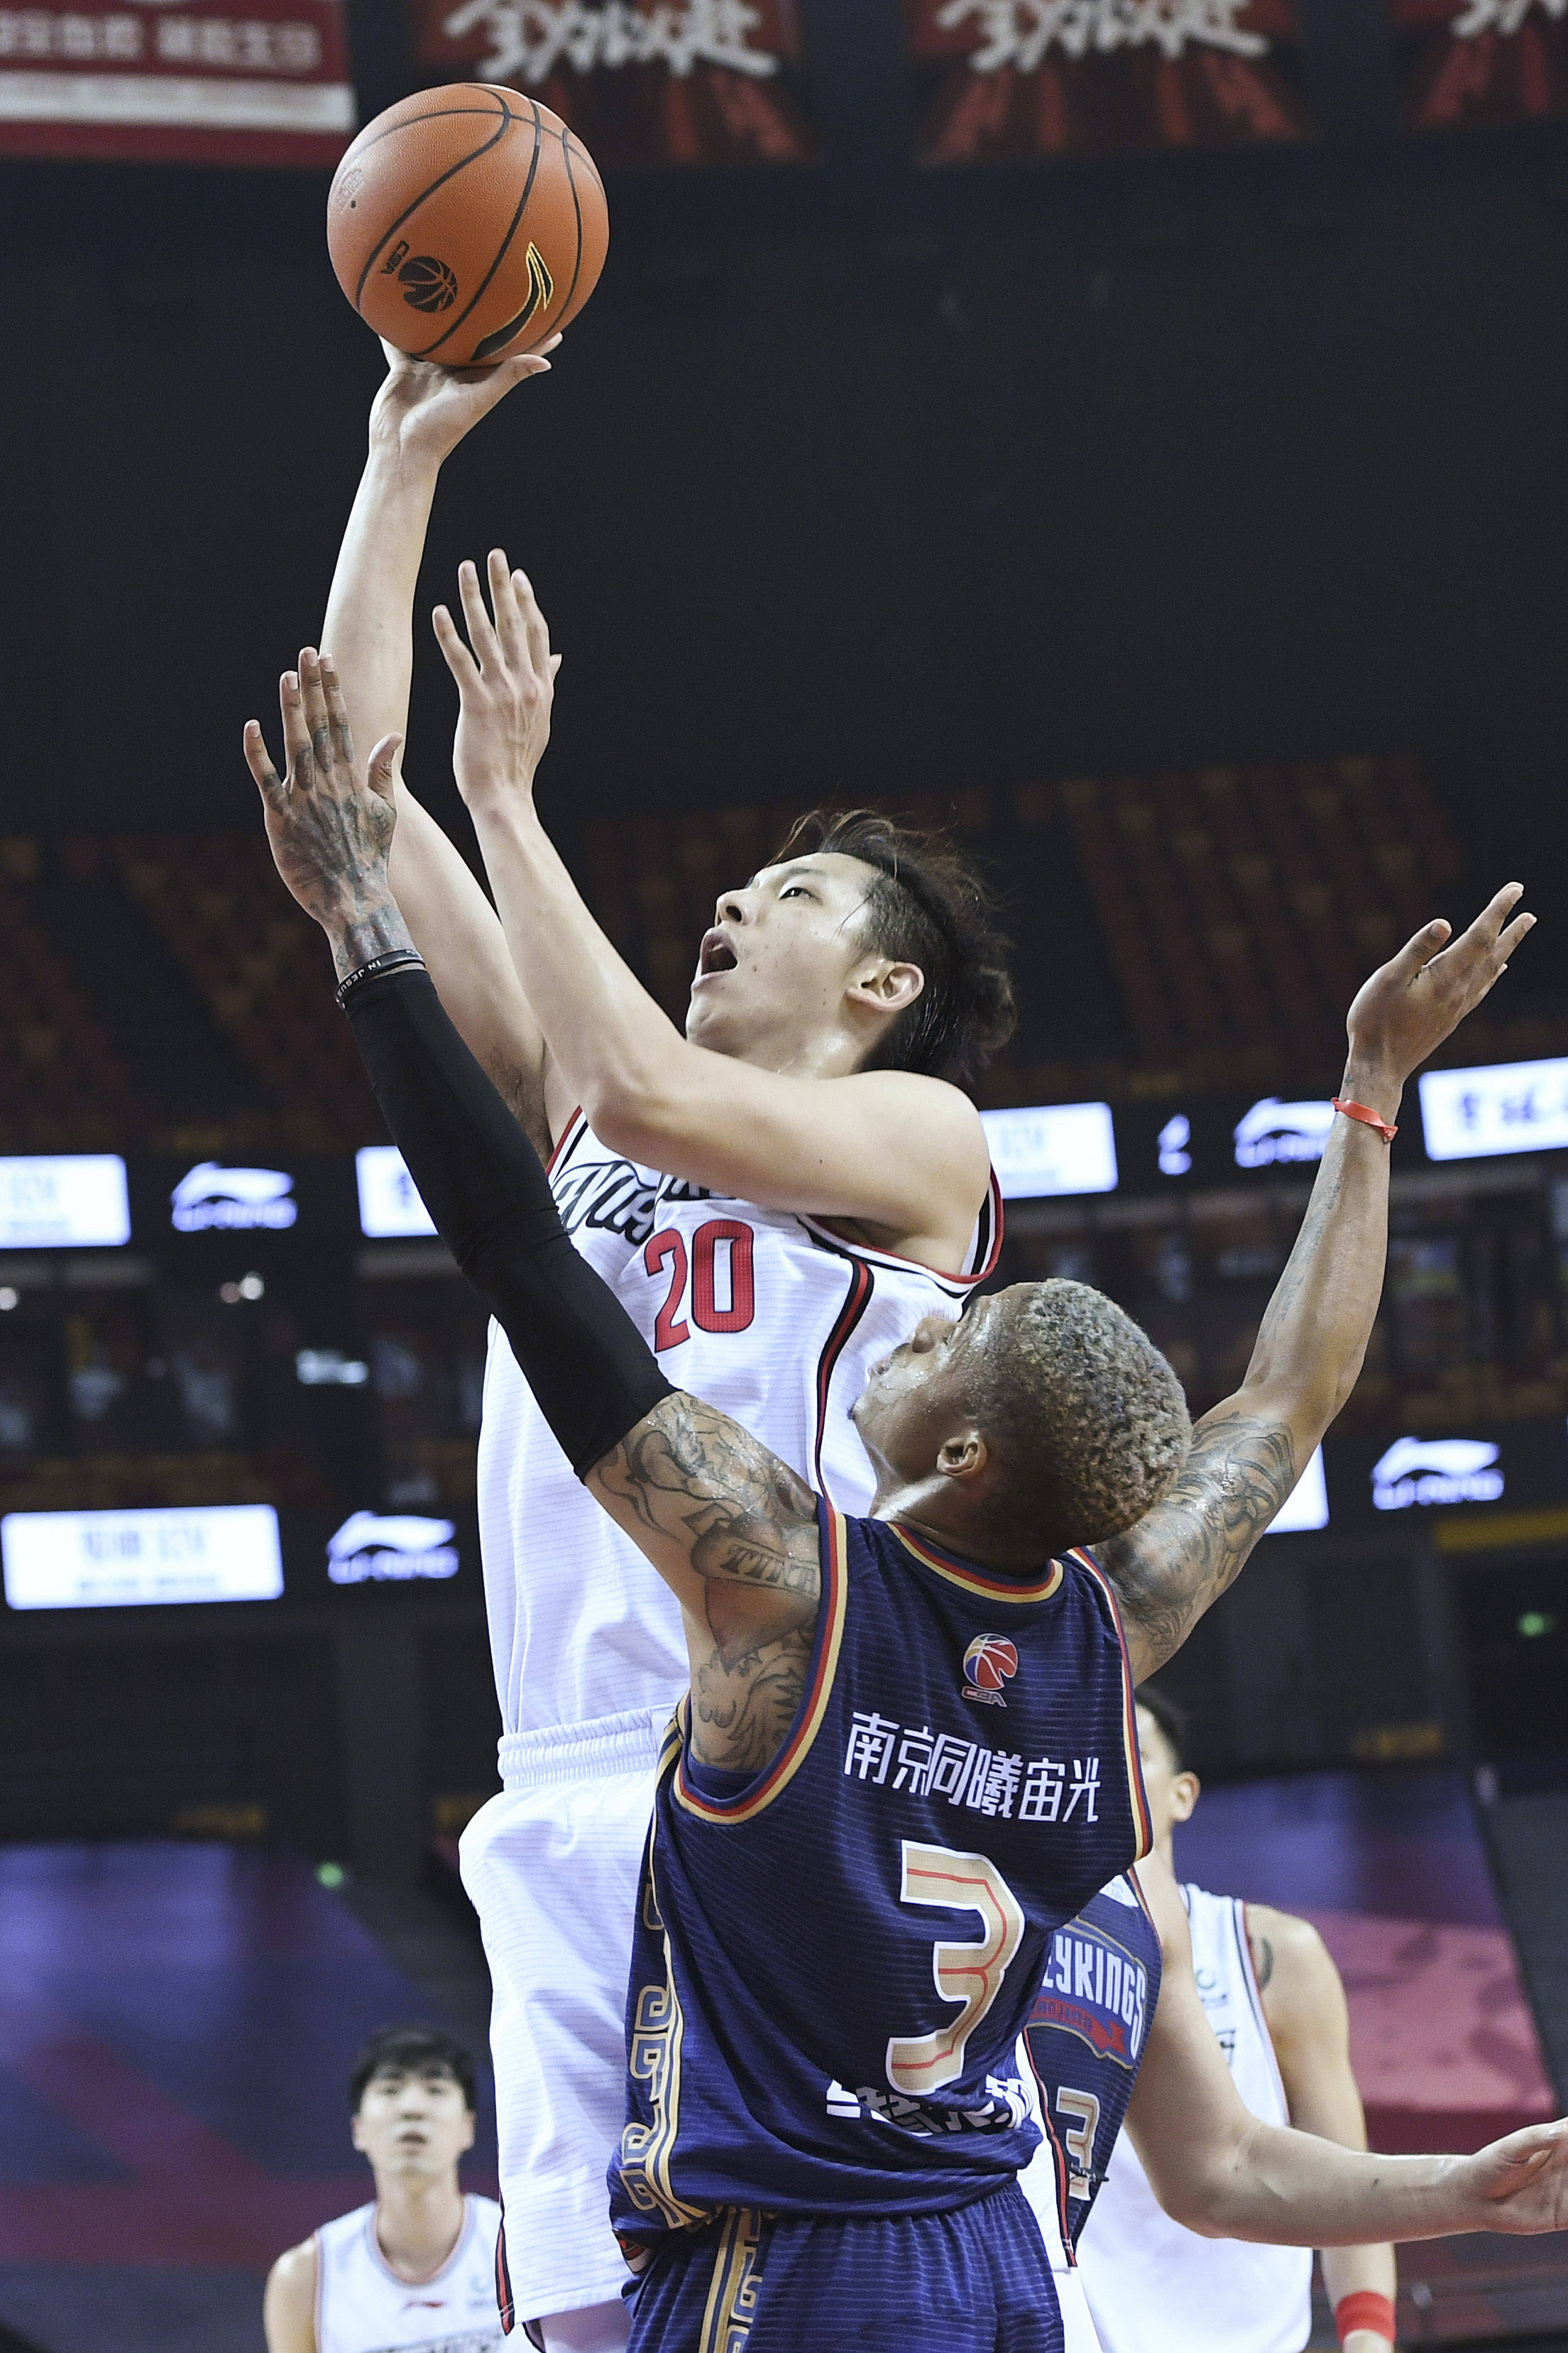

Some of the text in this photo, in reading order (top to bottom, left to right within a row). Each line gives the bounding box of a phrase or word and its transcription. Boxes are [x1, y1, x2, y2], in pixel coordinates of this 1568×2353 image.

[380, 240, 410, 275] CBA
[337, 960, 381, 997] IN JESUS
[643, 1218, 755, 1354] 20
[961, 1686, 1007, 1708] CBA
[844, 1711, 1101, 1823] 南京同曦宙光
[886, 1839, 1026, 2096] 3
[1056, 2086, 1100, 2201] 3
